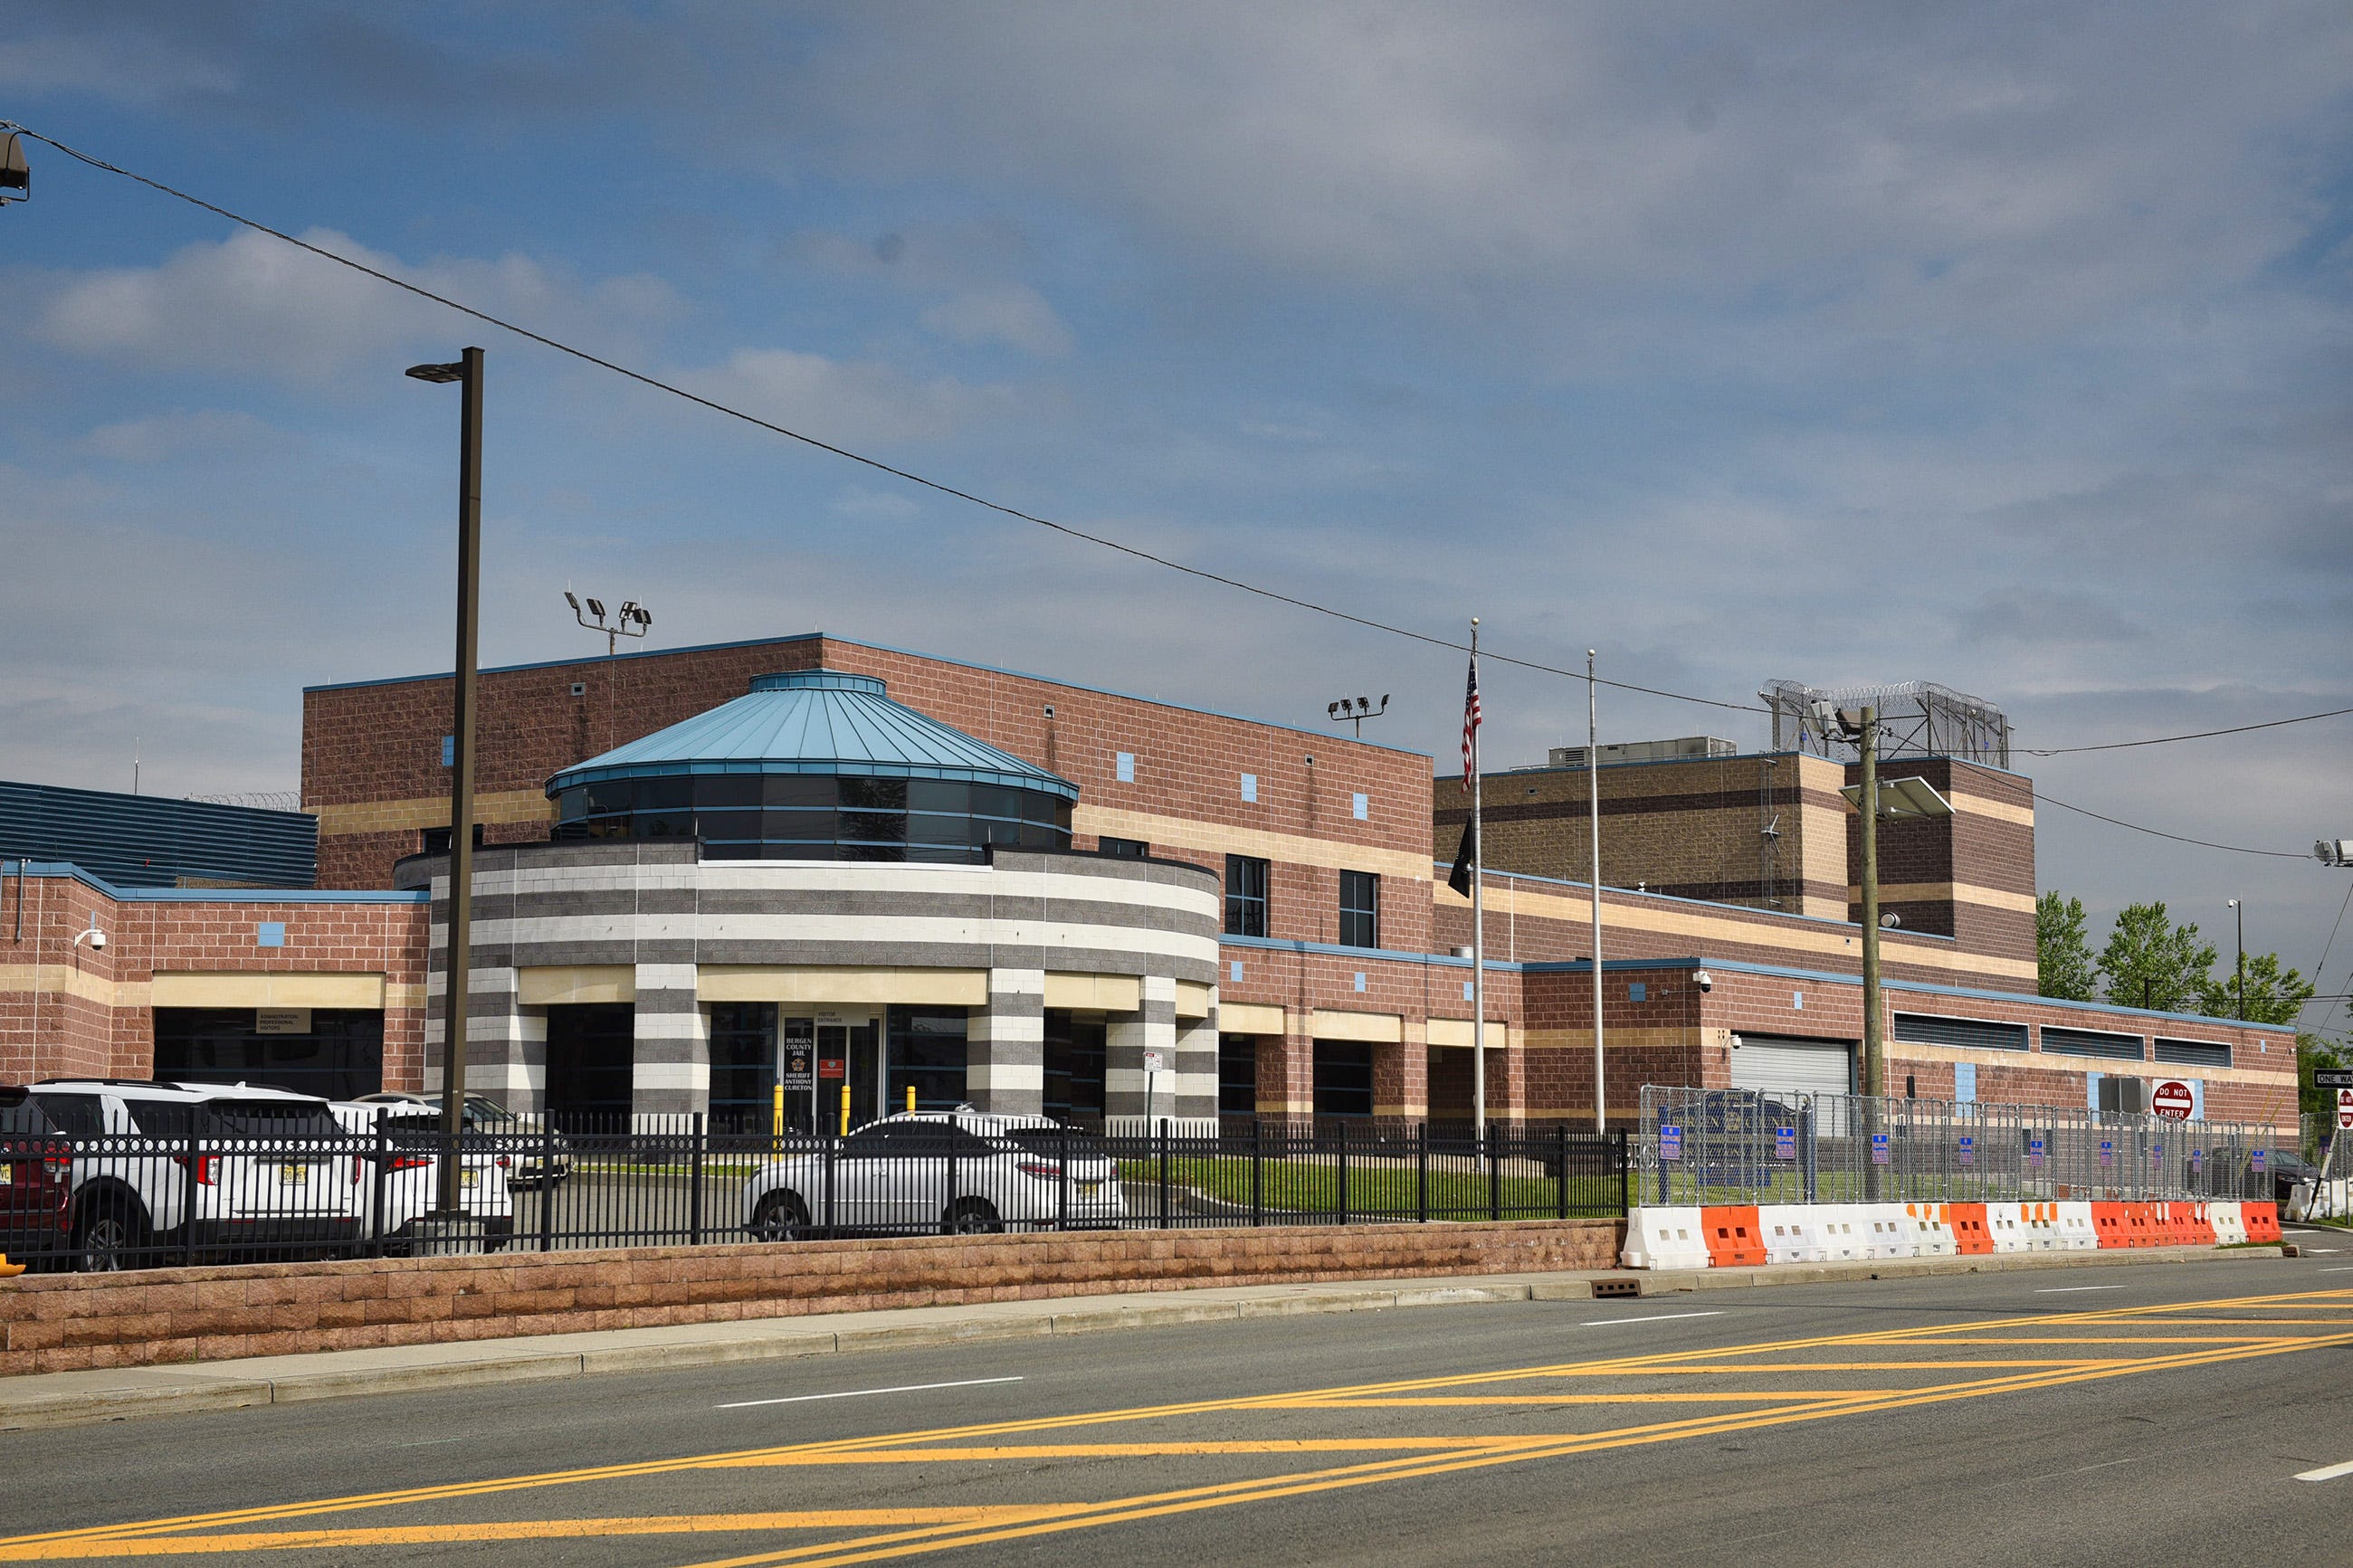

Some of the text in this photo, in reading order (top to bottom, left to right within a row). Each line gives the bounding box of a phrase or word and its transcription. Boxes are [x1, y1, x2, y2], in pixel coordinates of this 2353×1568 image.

[2319, 1075, 2353, 1084] ONE WA
[2159, 1088, 2187, 1097] DO NOT
[2160, 1108, 2185, 1118] ENTER
